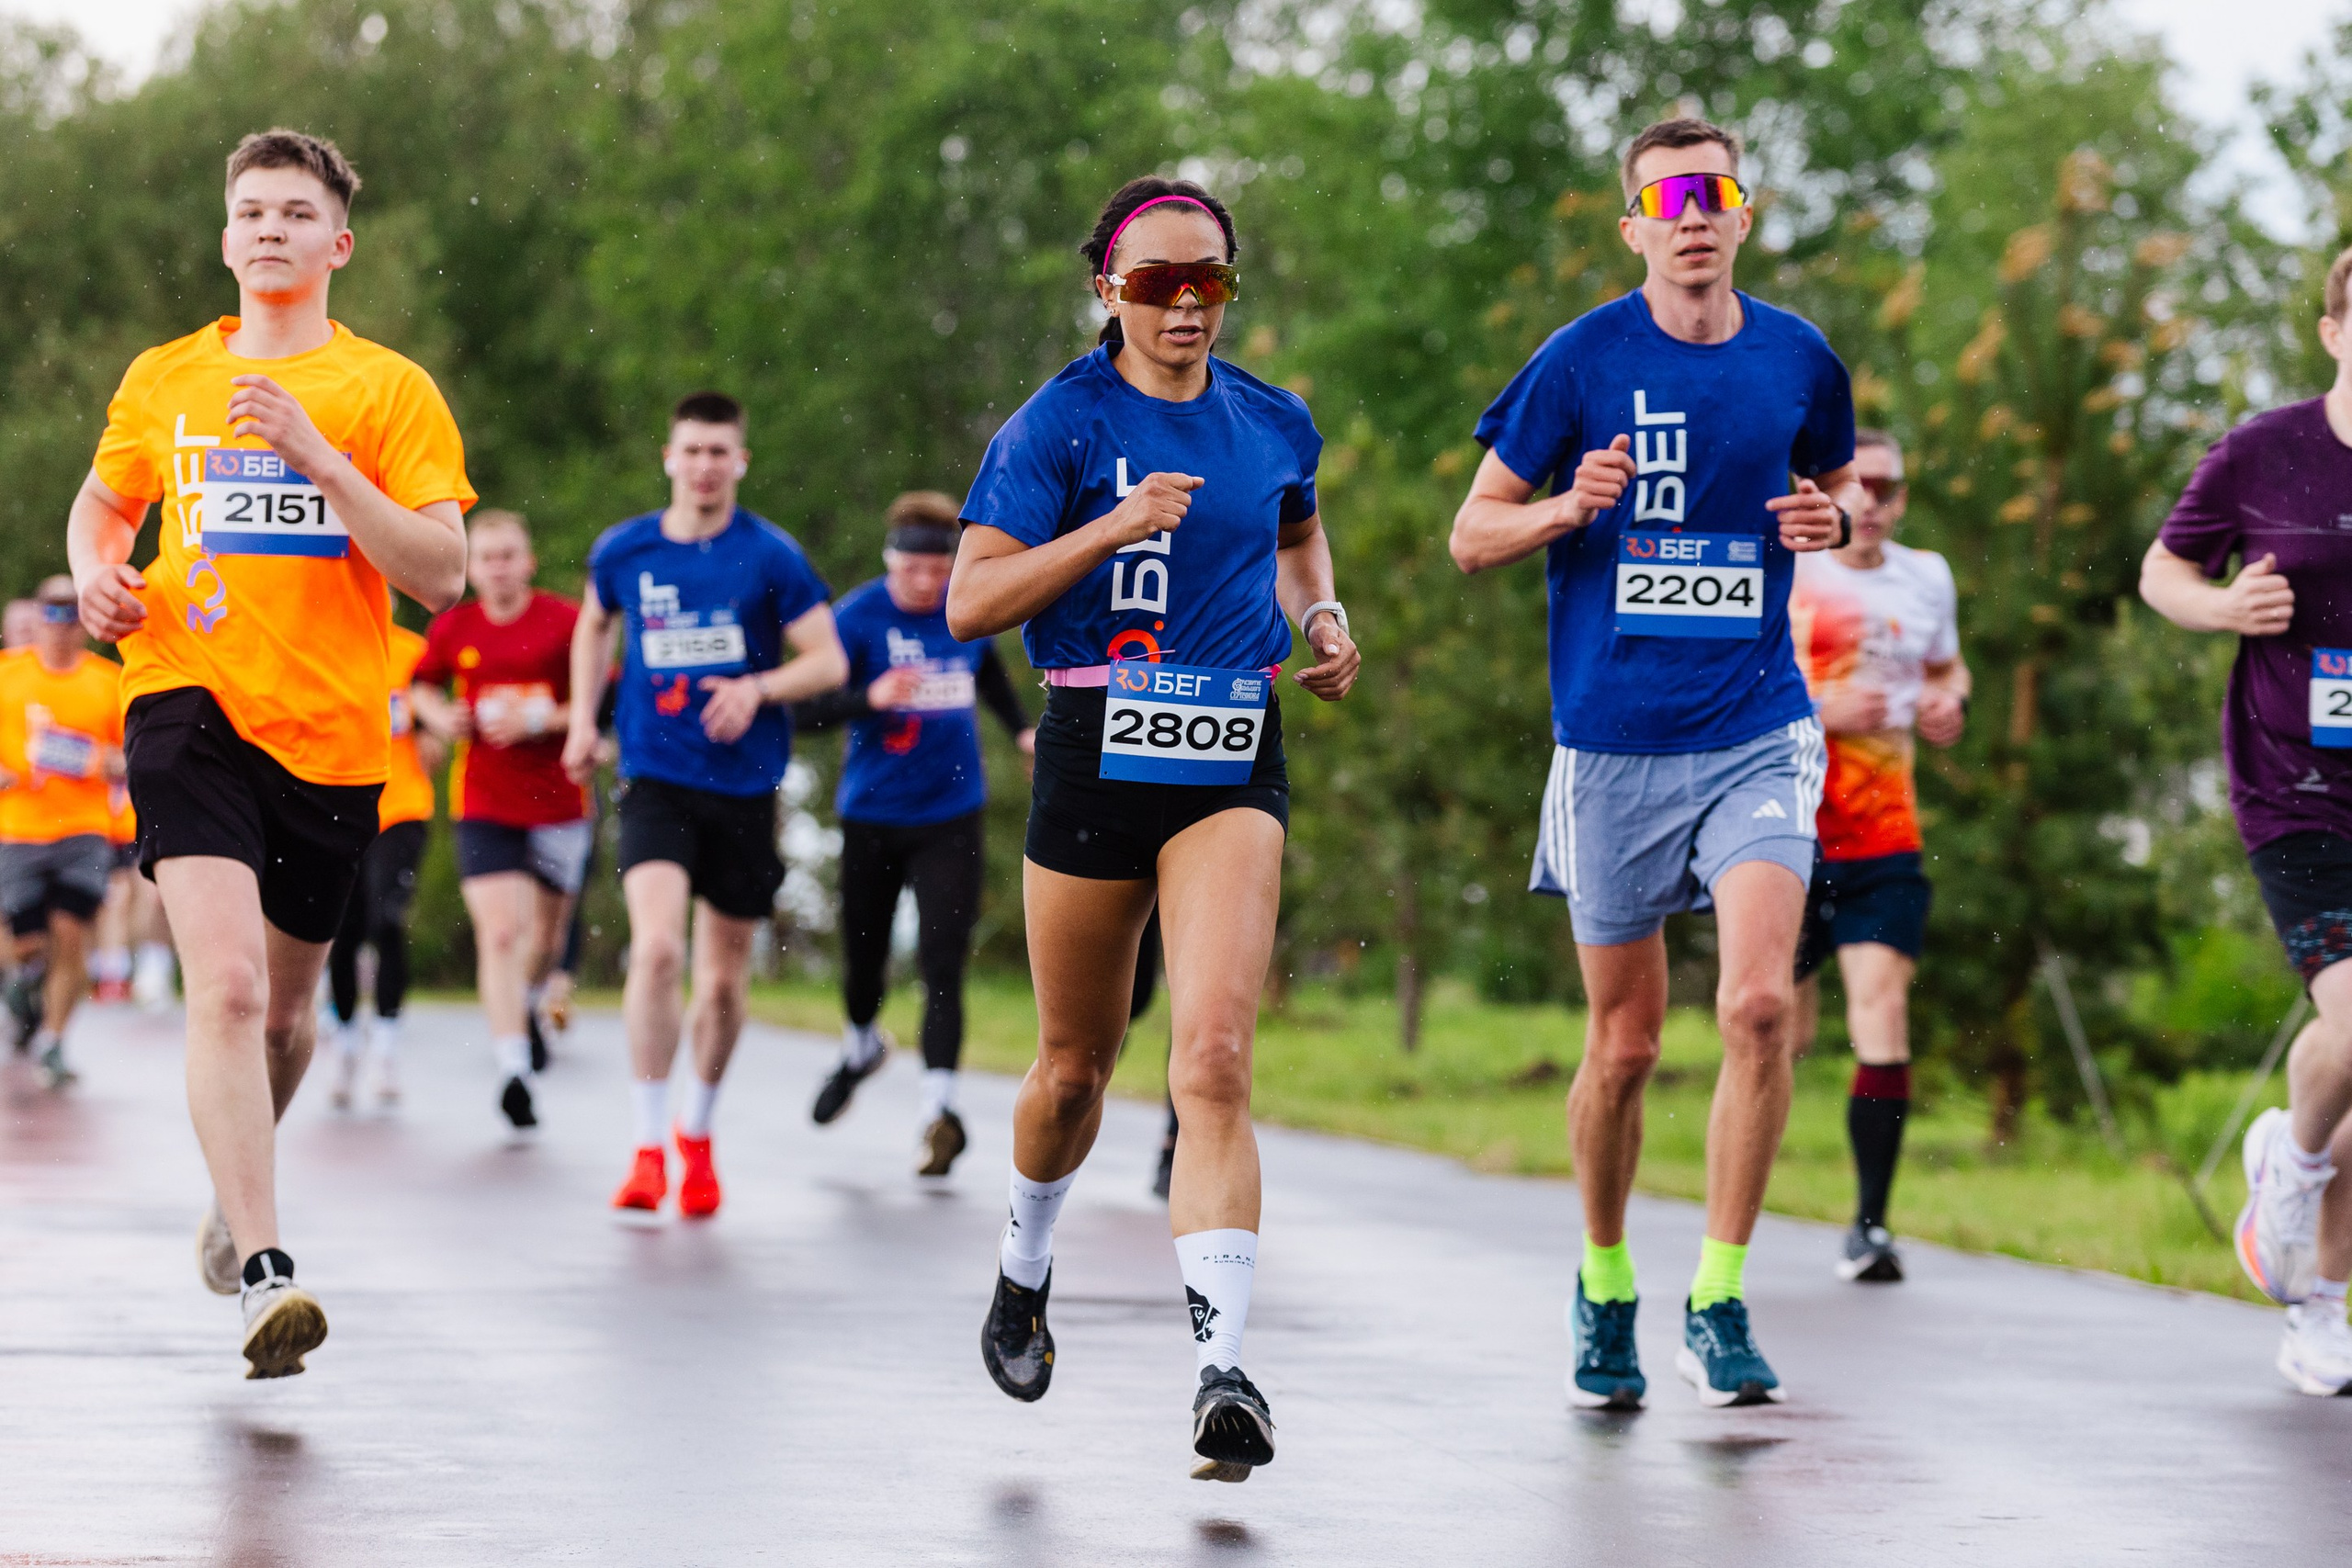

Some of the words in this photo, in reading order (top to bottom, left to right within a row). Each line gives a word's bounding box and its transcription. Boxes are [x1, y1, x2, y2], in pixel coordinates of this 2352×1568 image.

[1634, 389, 1687, 533] БЕГ
[224, 491, 325, 525] 2151
[1626, 574, 1754, 607] 2204
[2328, 690, 2352, 716] 2
[1109, 708, 1256, 752] 2808
